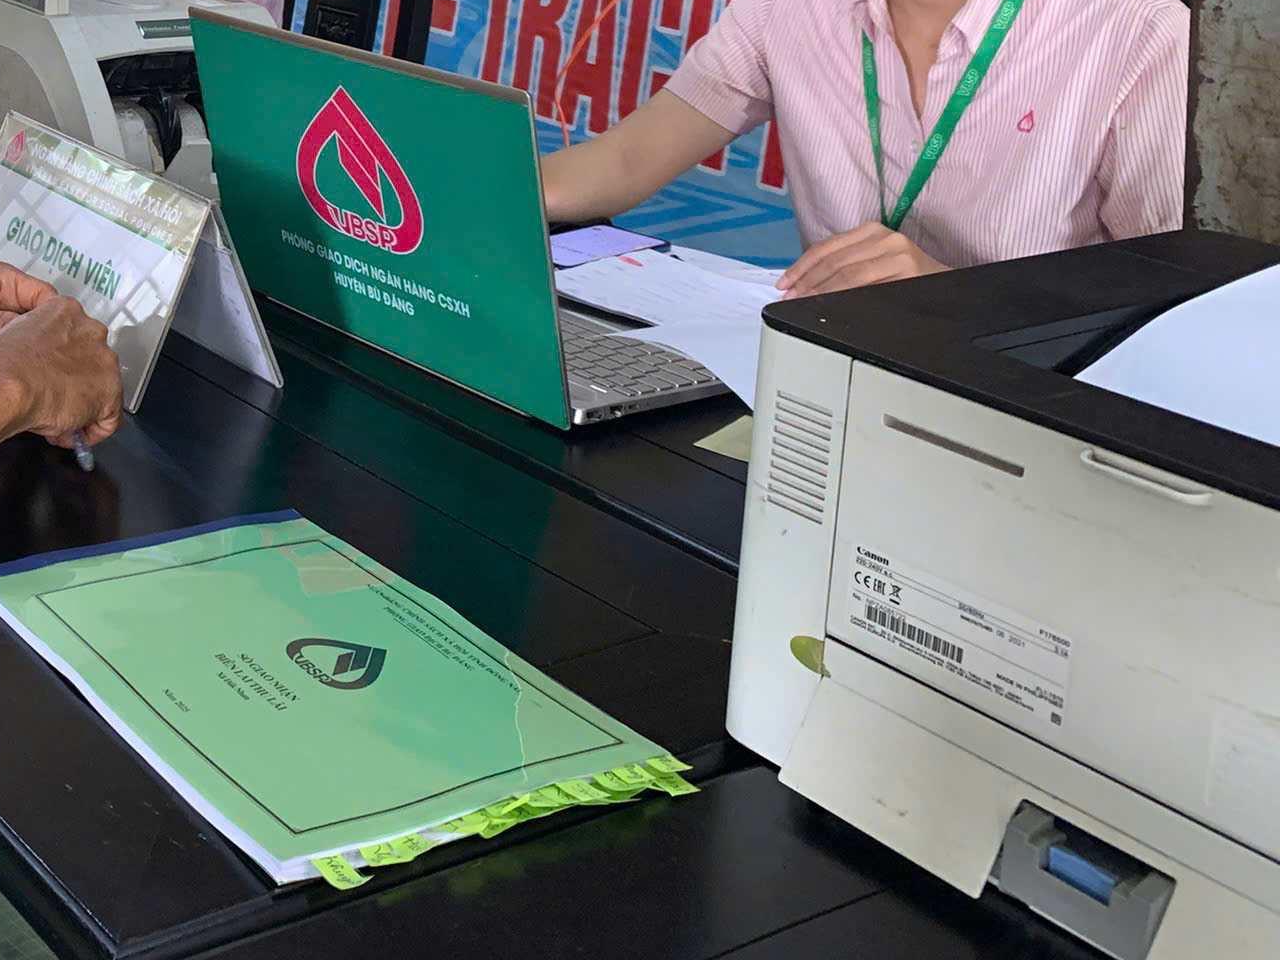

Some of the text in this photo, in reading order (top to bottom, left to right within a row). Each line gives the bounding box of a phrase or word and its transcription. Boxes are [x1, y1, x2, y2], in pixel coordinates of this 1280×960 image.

[993, 0, 1016, 31] VBSP
[956, 67, 980, 98] VBSP
[922, 132, 944, 161] VBSP
[58, 151, 86, 179] HÀNG
[87, 167, 118, 196] CHÍNH
[119, 176, 146, 208] SÁCH
[144, 196, 162, 218] XÃ
[160, 203, 183, 227] HỘI
[98, 200, 130, 223] SOCIAL
[326, 203, 399, 254] VBSP
[6, 216, 121, 301] GIAO DỊCH VIÊN
[281, 229, 316, 254] PHÒNG
[316, 243, 344, 266] GIAO
[370, 264, 403, 290] NGÂN
[403, 278, 437, 305] HÀNG
[437, 292, 472, 319] CSXH
[367, 283, 382, 303] BÙ
[857, 546, 889, 566] Canon
[234, 669, 253, 684] LAI
[249, 662, 274, 682] GIAO
[271, 680, 300, 702] NHẬN
[293, 651, 332, 683] VBSP
[996, 672, 1014, 686] MADE
